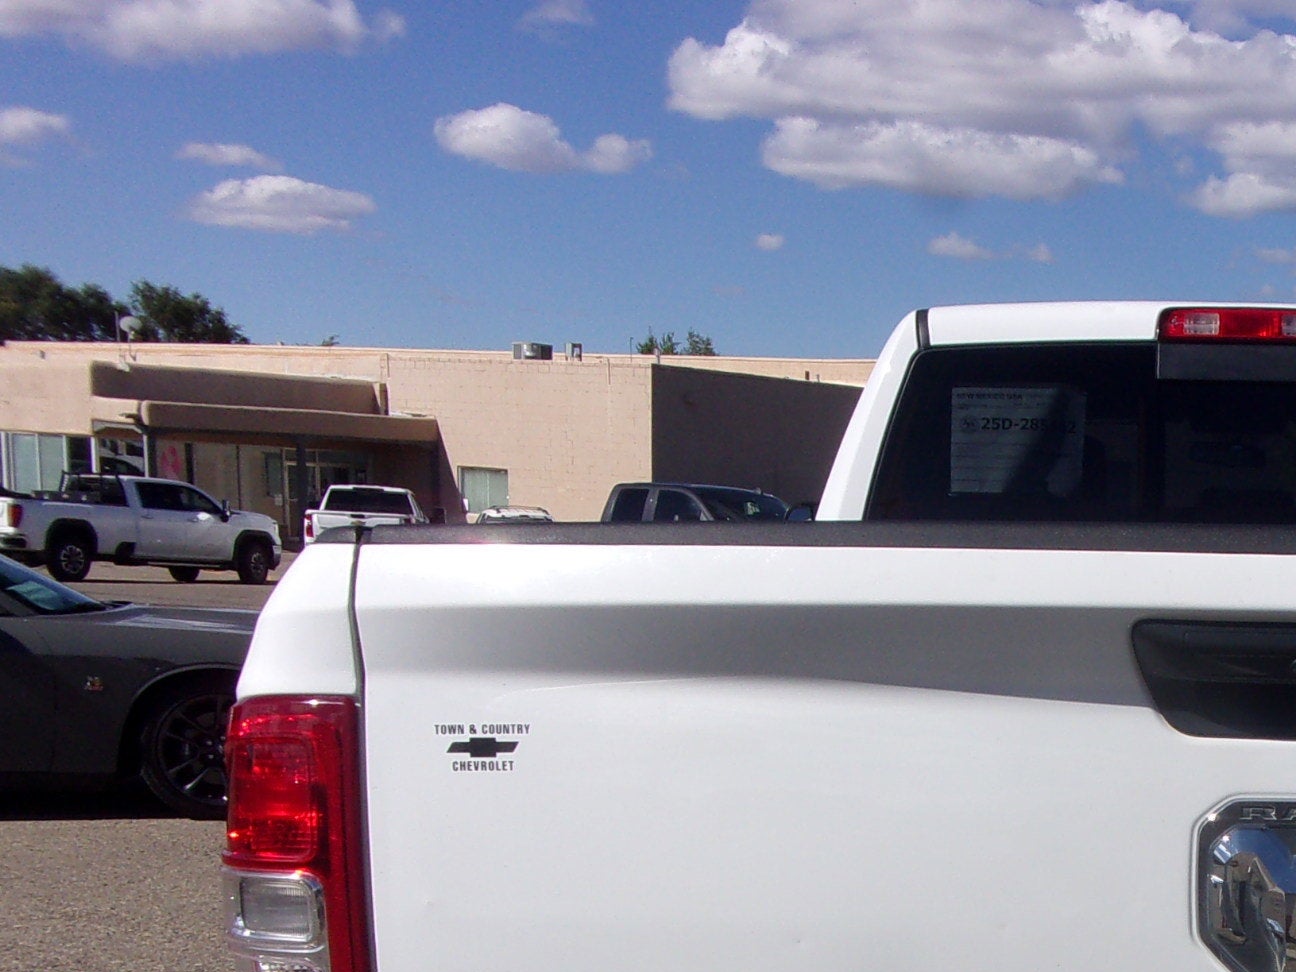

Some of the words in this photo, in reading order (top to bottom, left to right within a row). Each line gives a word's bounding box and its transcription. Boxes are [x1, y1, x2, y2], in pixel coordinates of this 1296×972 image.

[434, 724, 464, 734] TOWN
[469, 724, 477, 734] &
[481, 724, 530, 734] COUNTRY
[452, 761, 514, 771] CHEVROLET
